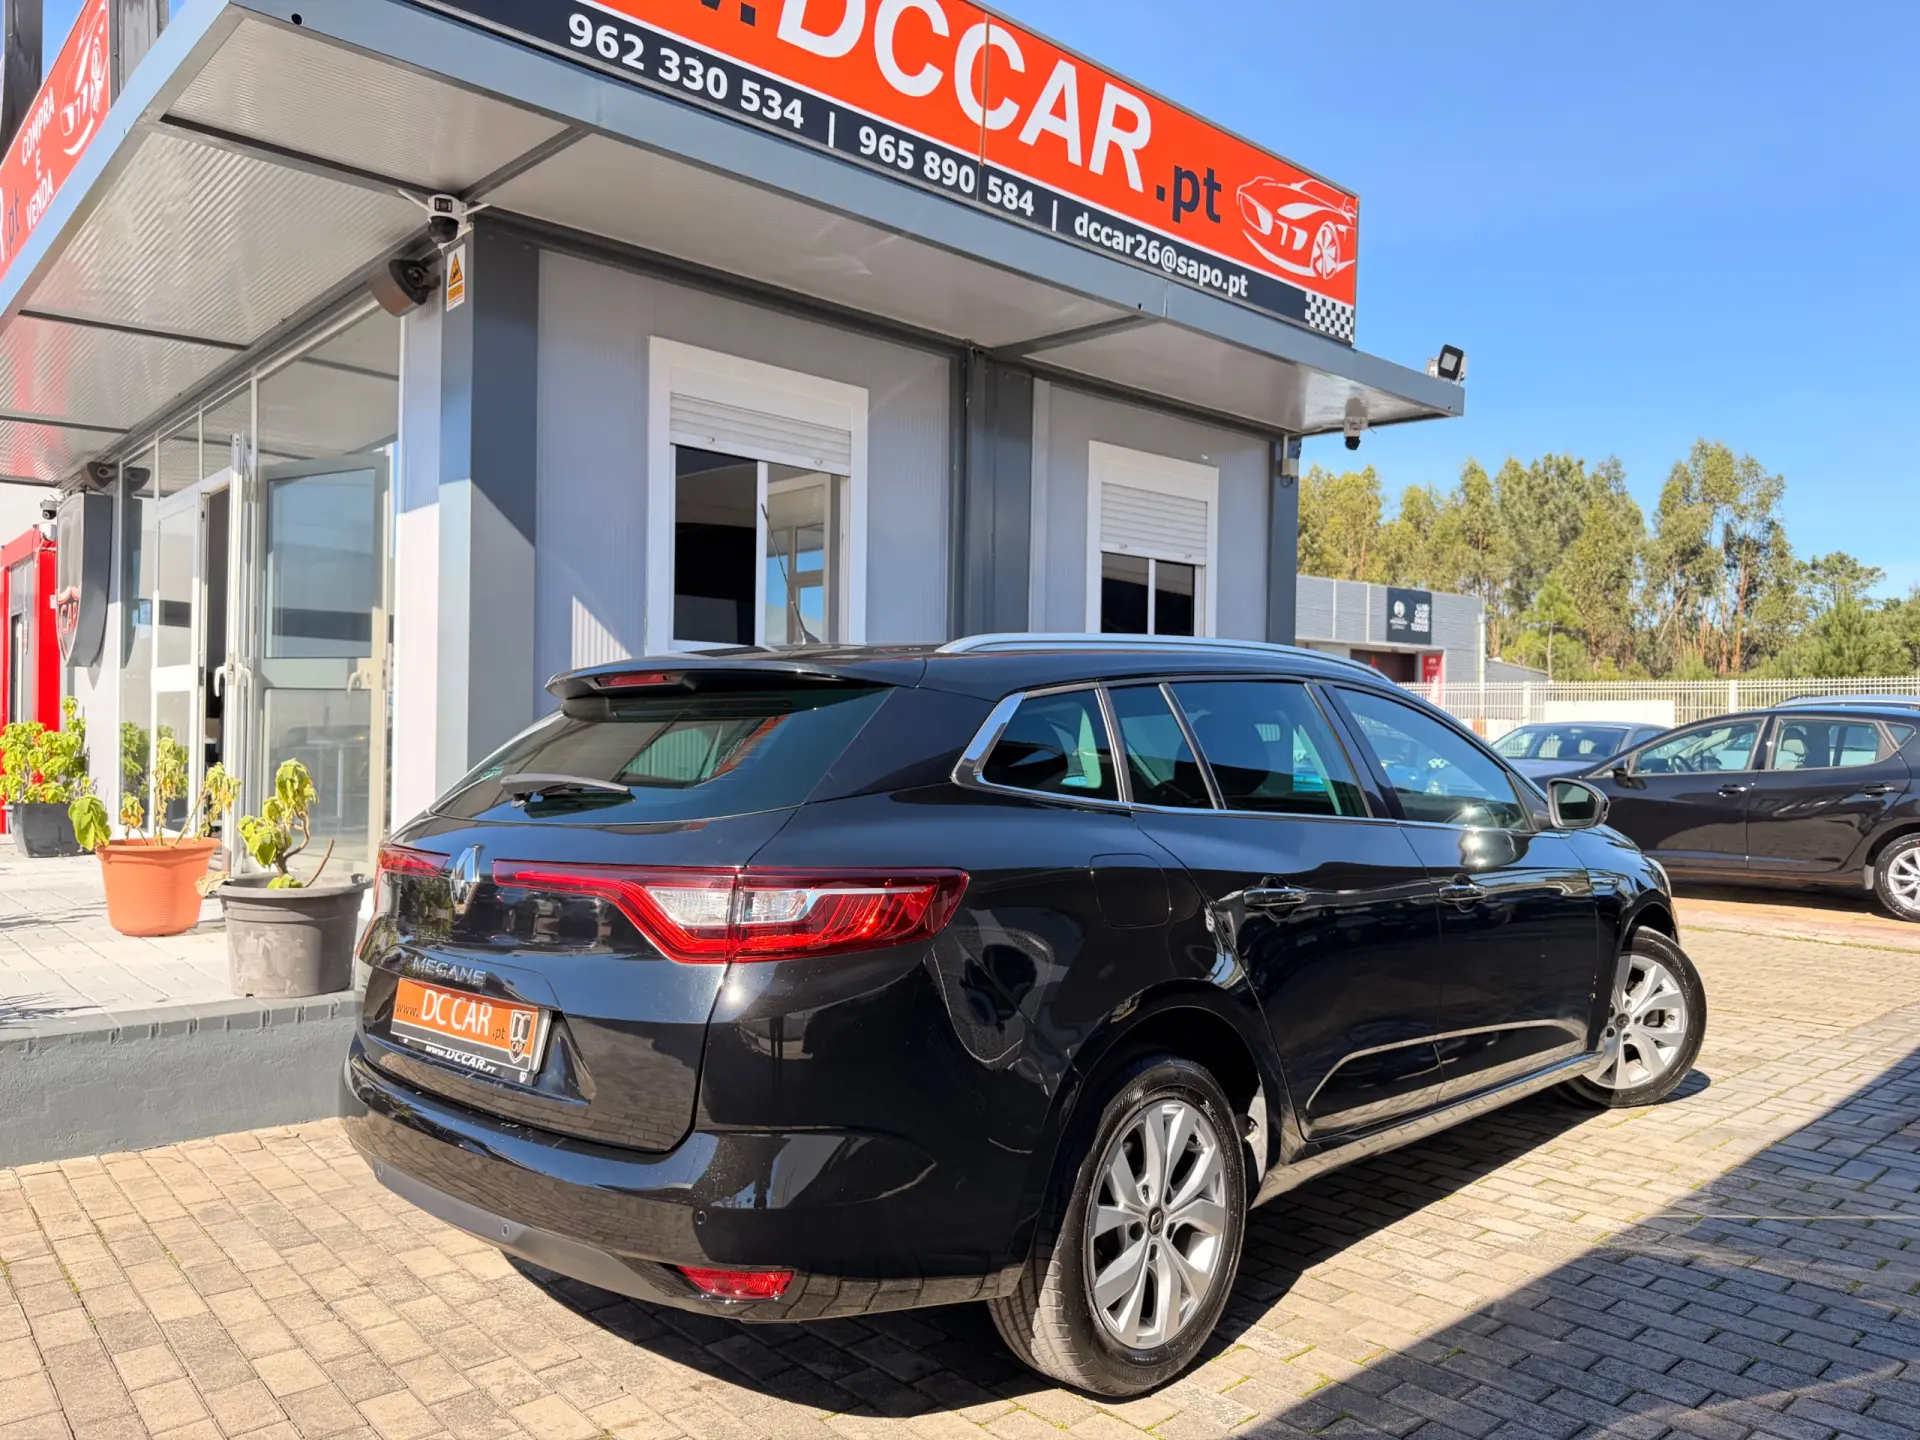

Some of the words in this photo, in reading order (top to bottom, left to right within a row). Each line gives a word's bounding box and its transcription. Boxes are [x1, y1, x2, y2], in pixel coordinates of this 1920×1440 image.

[21, 86, 56, 167] COMPRA
[568, 13, 645, 71] 962
[657, 47, 729, 101] 330
[740, 81, 804, 130] 534
[858, 125, 915, 171] 965
[922, 150, 976, 194] 890
[986, 177, 1035, 217] 584
[1074, 211, 1249, 298] dccar26@sapo.pt
[35, 147, 42, 180] E
[26, 168, 54, 231] VENDA
[411, 956, 487, 988] MEGANE
